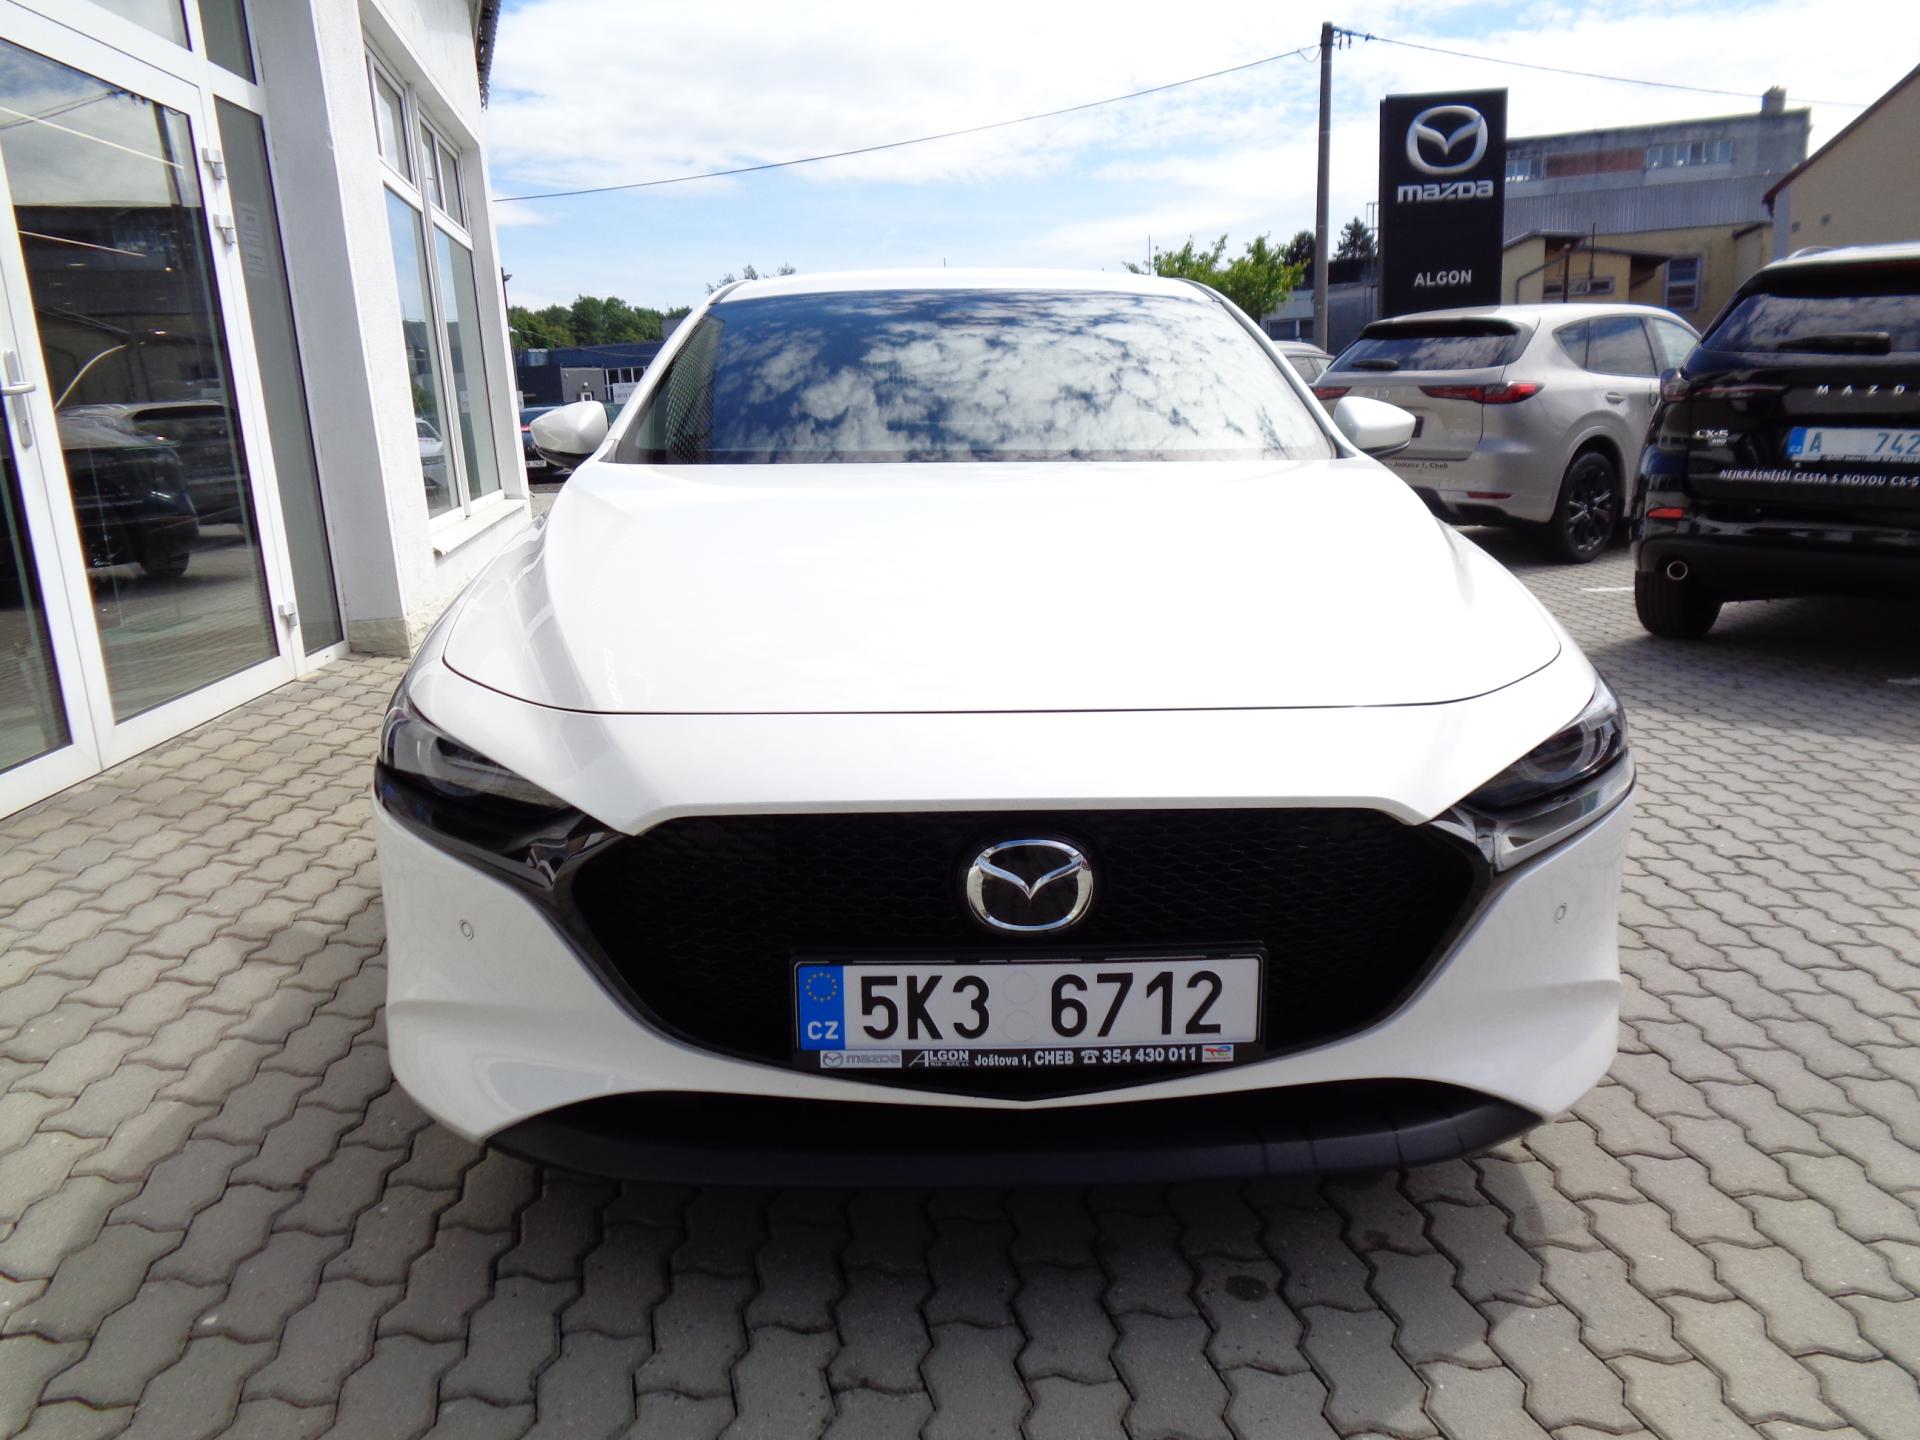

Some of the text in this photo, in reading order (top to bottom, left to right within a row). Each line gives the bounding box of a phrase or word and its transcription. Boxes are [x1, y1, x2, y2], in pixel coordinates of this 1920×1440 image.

[1413, 269, 1472, 288] ALGON
[1816, 384, 1920, 397] MAZD
[1695, 429, 1729, 439] CX-5
[1794, 472, 1828, 485] CESTA
[1830, 474, 1839, 485] S
[1842, 474, 1887, 487] NOVOU
[860, 970, 1224, 1041] 5K3 6712
[806, 1020, 839, 1041] CZ
[908, 1050, 969, 1068] ALGON
[974, 1047, 1197, 1068] Joštova 1, CHEB 354 430 011
